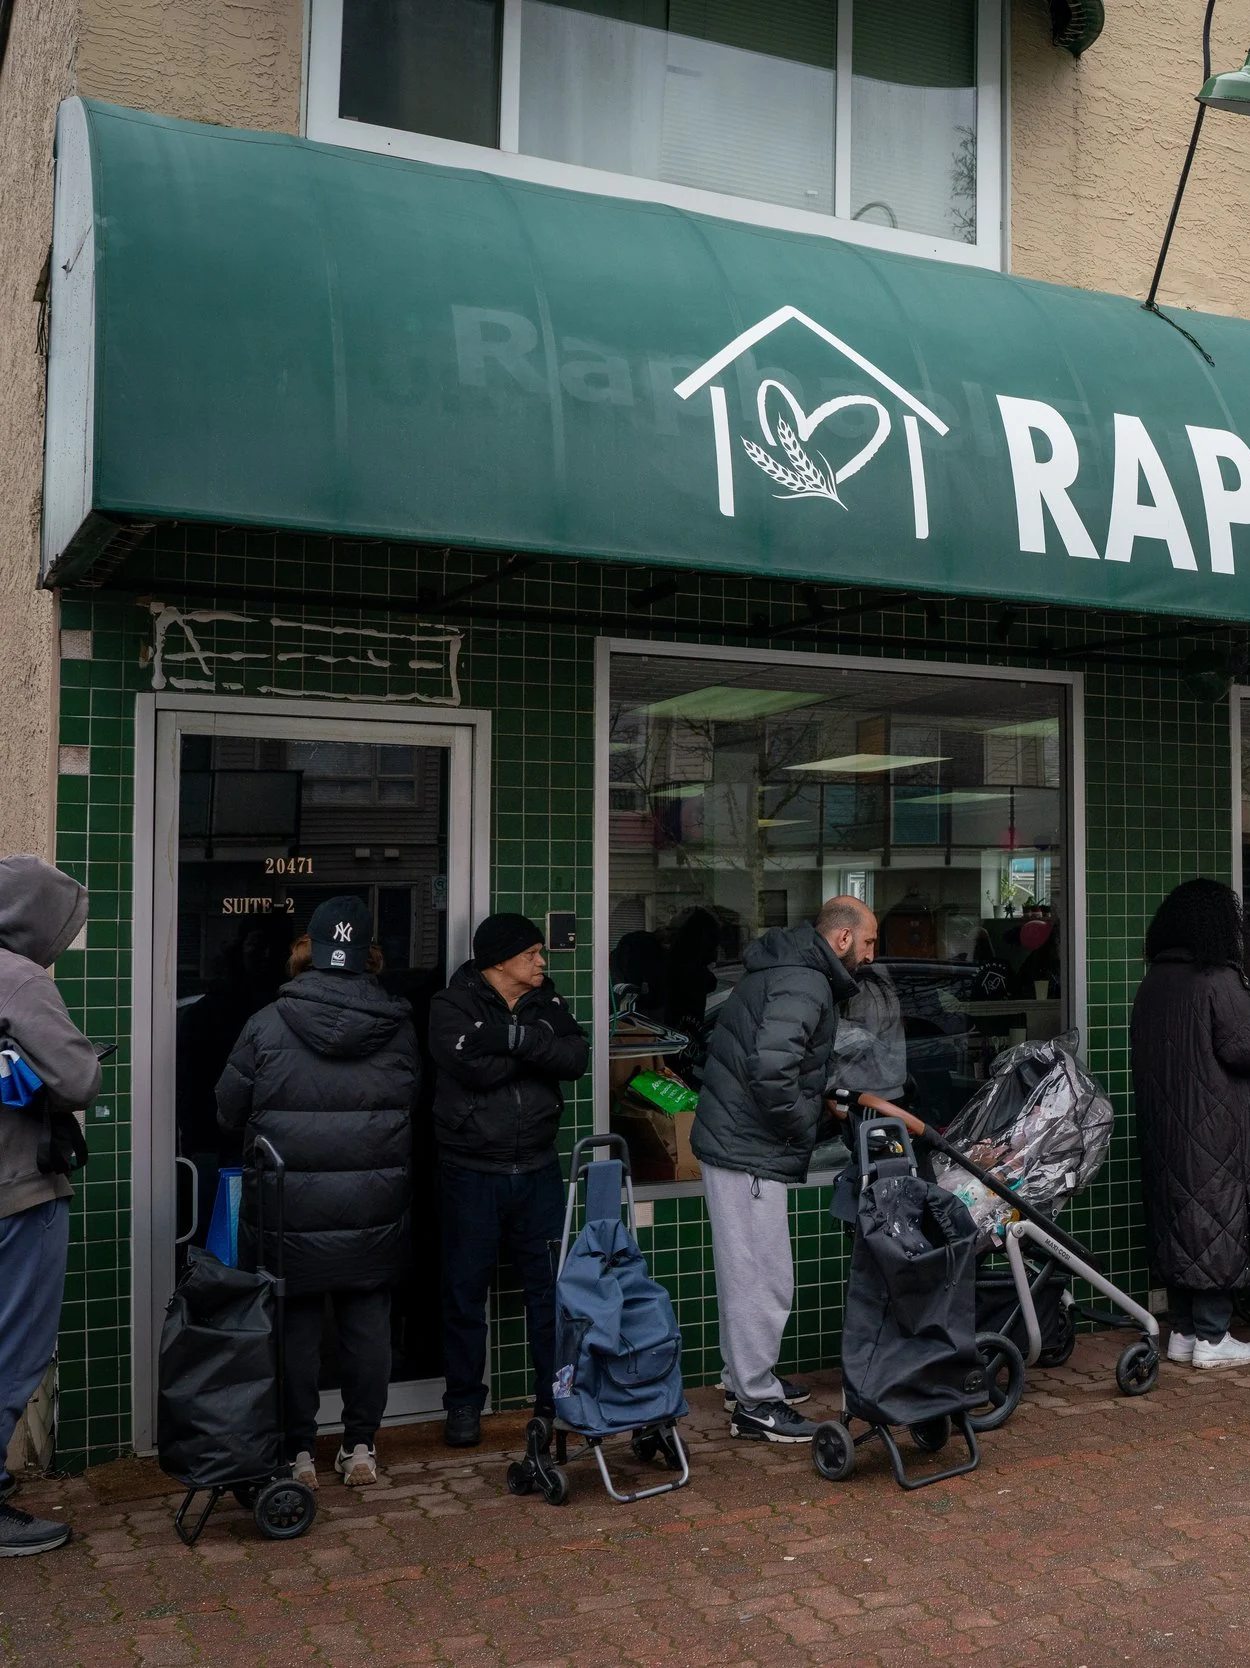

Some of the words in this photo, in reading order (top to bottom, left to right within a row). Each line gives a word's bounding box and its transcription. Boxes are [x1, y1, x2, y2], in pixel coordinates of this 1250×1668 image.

[264, 857, 314, 875] 20471
[222, 897, 295, 915] SUITE-2
[1044, 1238, 1072, 1261] MAXI-COSI
